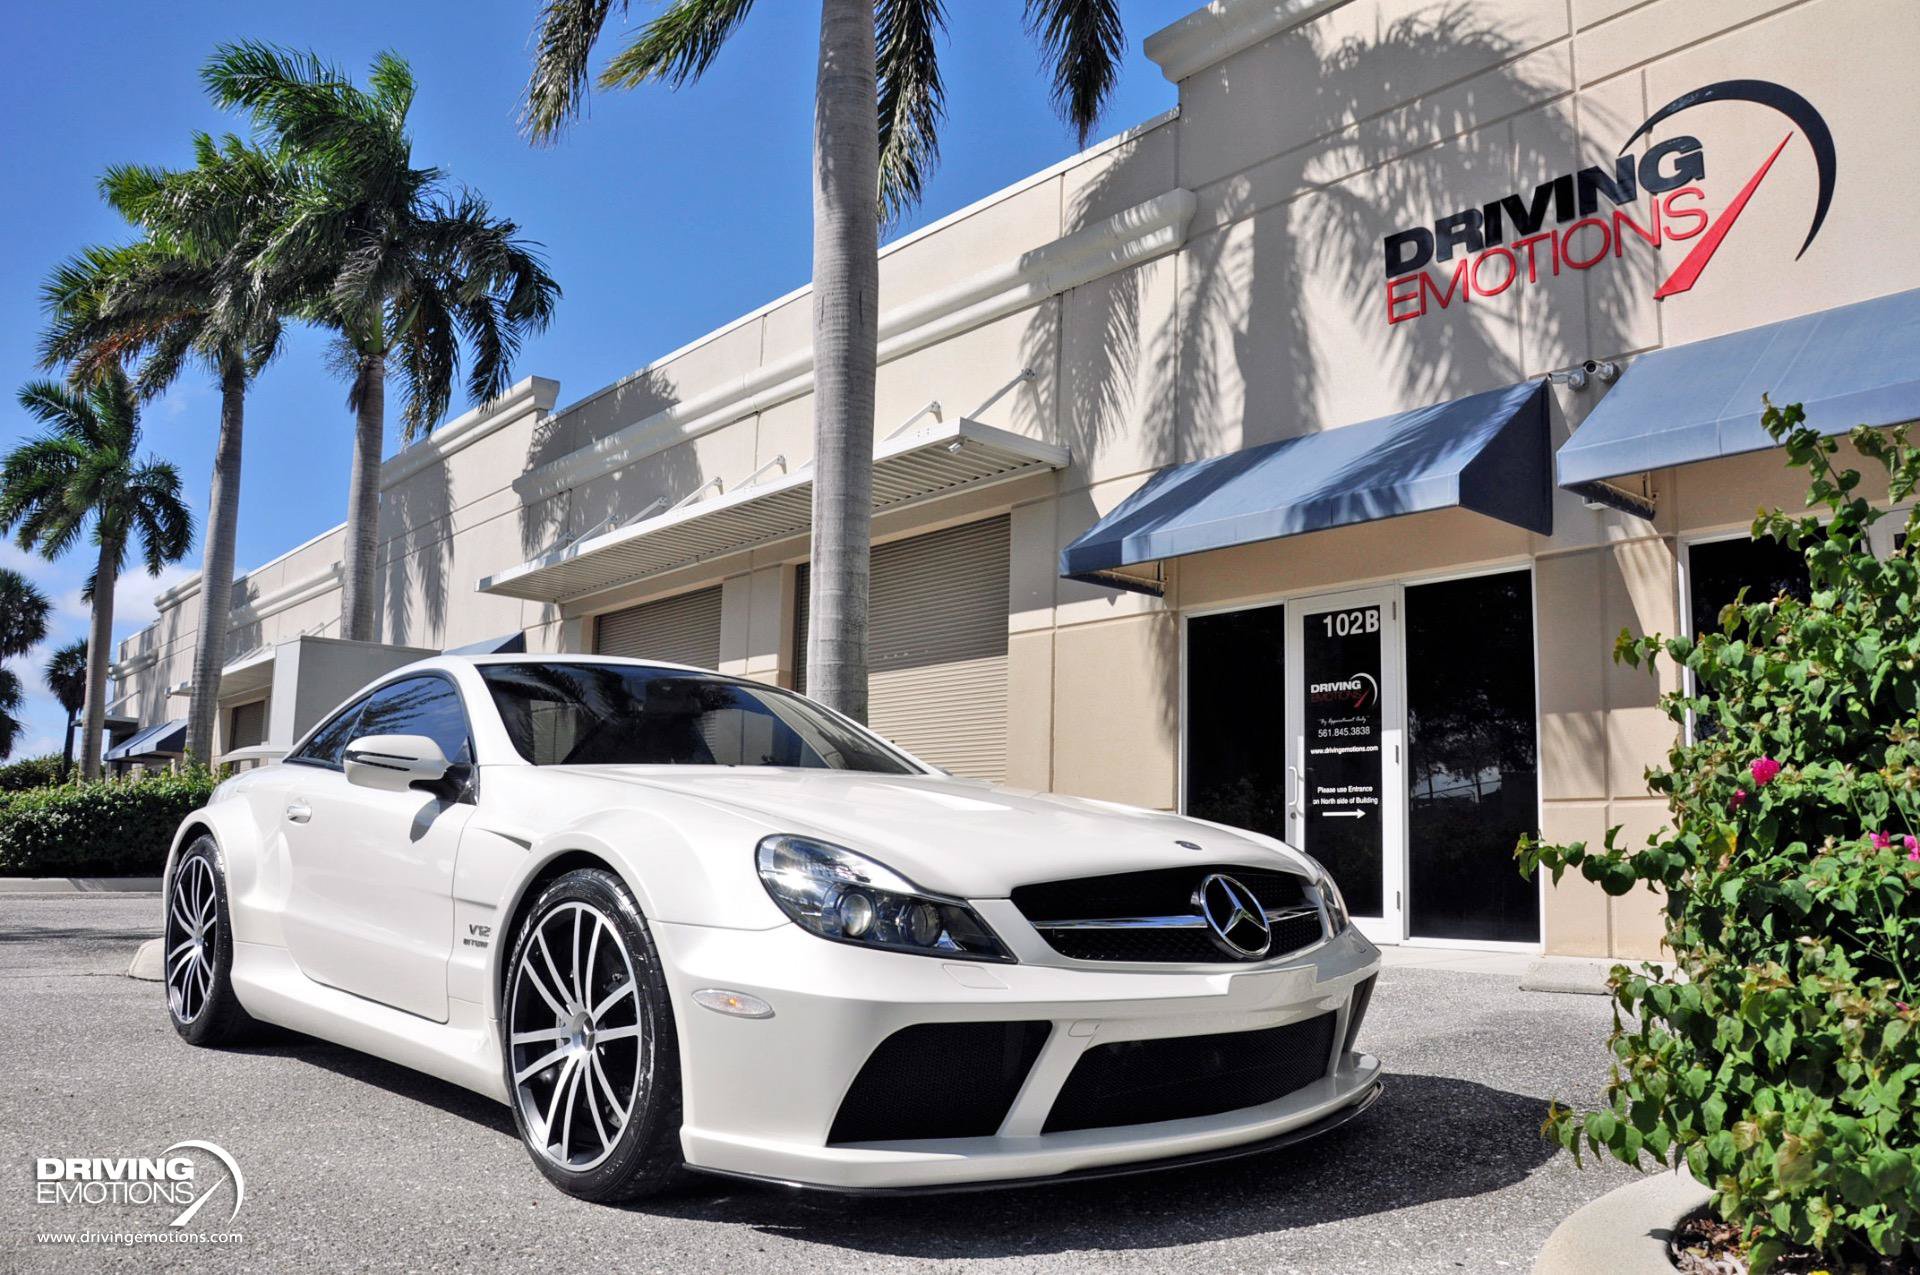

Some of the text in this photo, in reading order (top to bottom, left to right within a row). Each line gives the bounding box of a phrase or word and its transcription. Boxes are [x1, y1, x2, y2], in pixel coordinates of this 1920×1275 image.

[1384, 135, 1706, 278] DRIVING
[1386, 187, 1709, 325] EMOTIONS
[1323, 610, 1379, 637] 102B
[1310, 680, 1362, 694] DRIVING
[1318, 726, 1371, 738] 561.845.3838
[1310, 745, 1379, 755] www.drivingemotions.com
[1317, 786, 1336, 794] Please
[1348, 785, 1373, 793] Entrance
[1356, 797, 1378, 805] Building
[469, 924, 490, 937] V12
